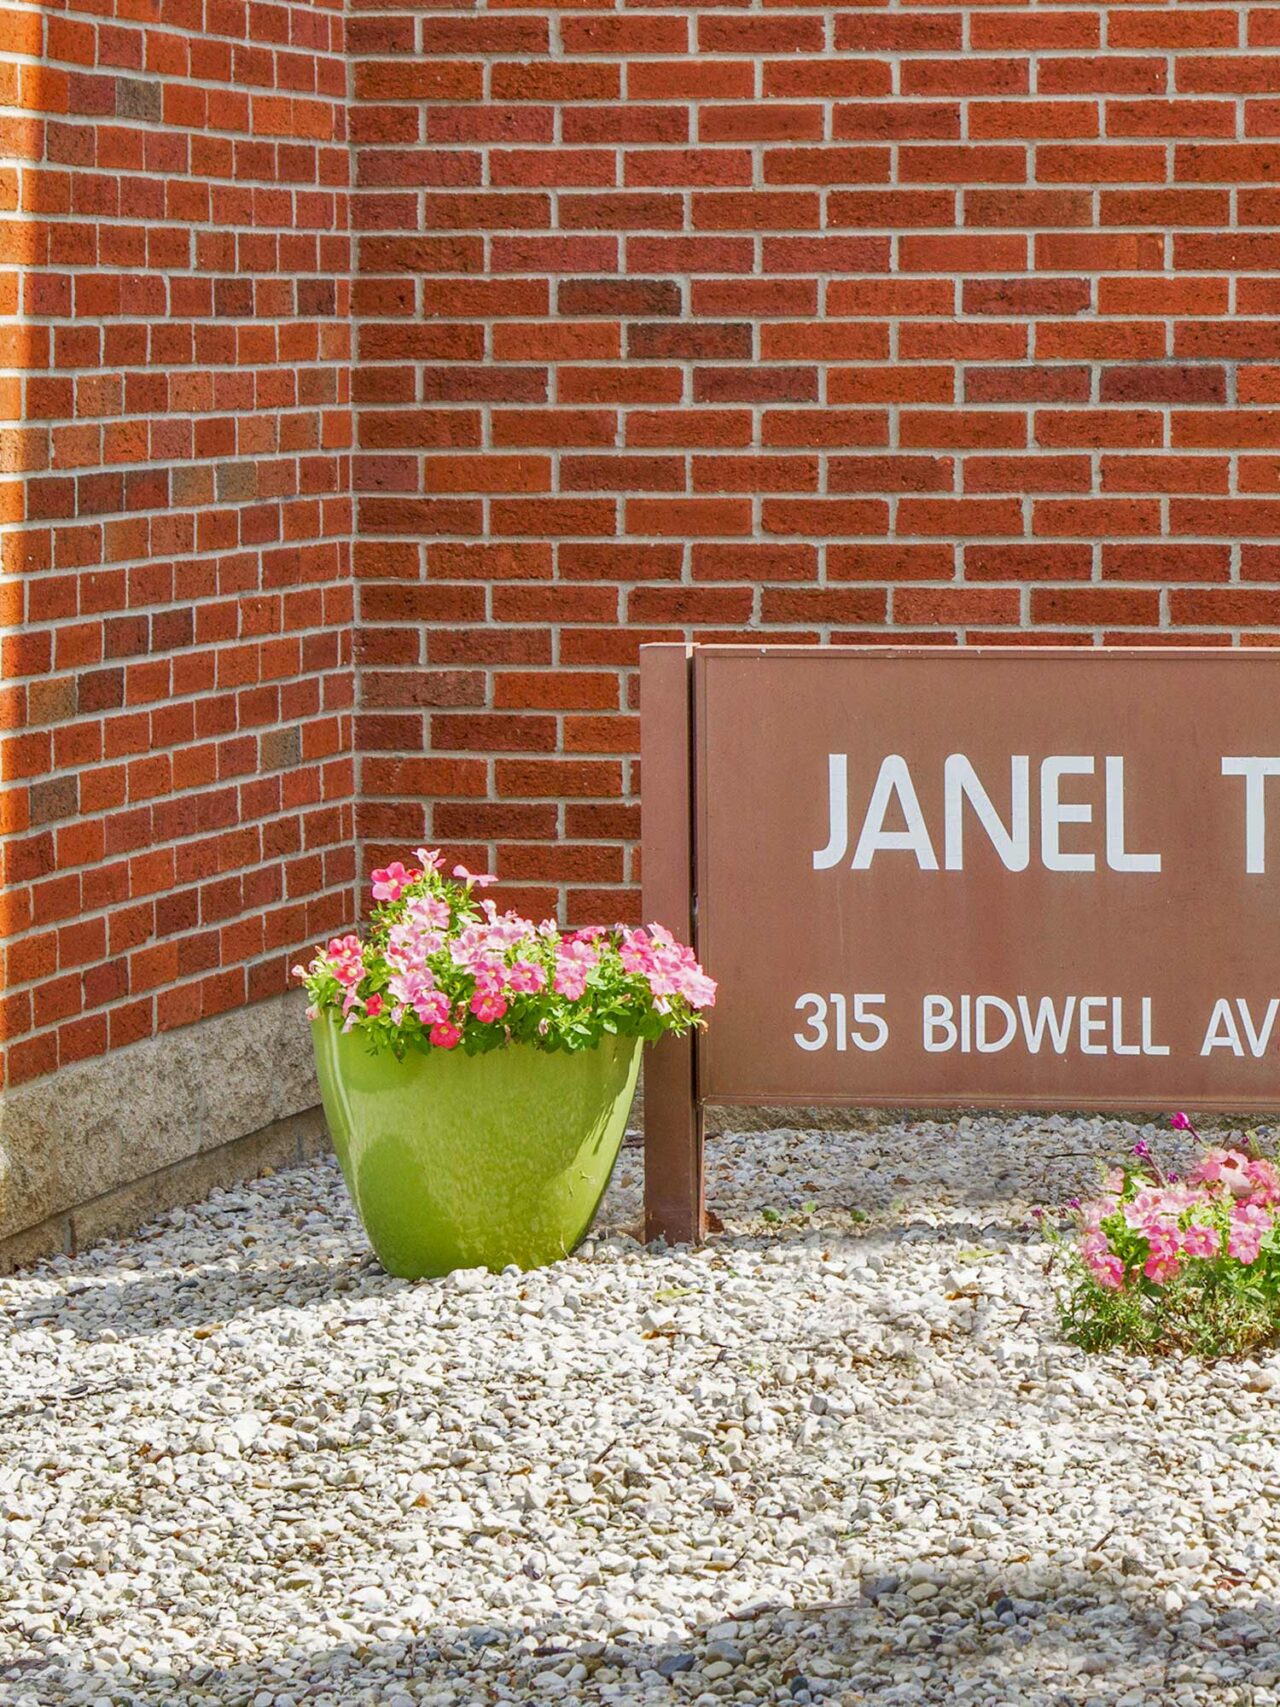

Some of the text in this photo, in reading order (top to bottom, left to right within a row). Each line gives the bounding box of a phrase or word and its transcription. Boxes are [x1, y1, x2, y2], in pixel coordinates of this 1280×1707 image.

[812, 753, 1162, 873] JANEL
[794, 992, 889, 1052] 315
[923, 994, 1170, 1056] BIDWELL
